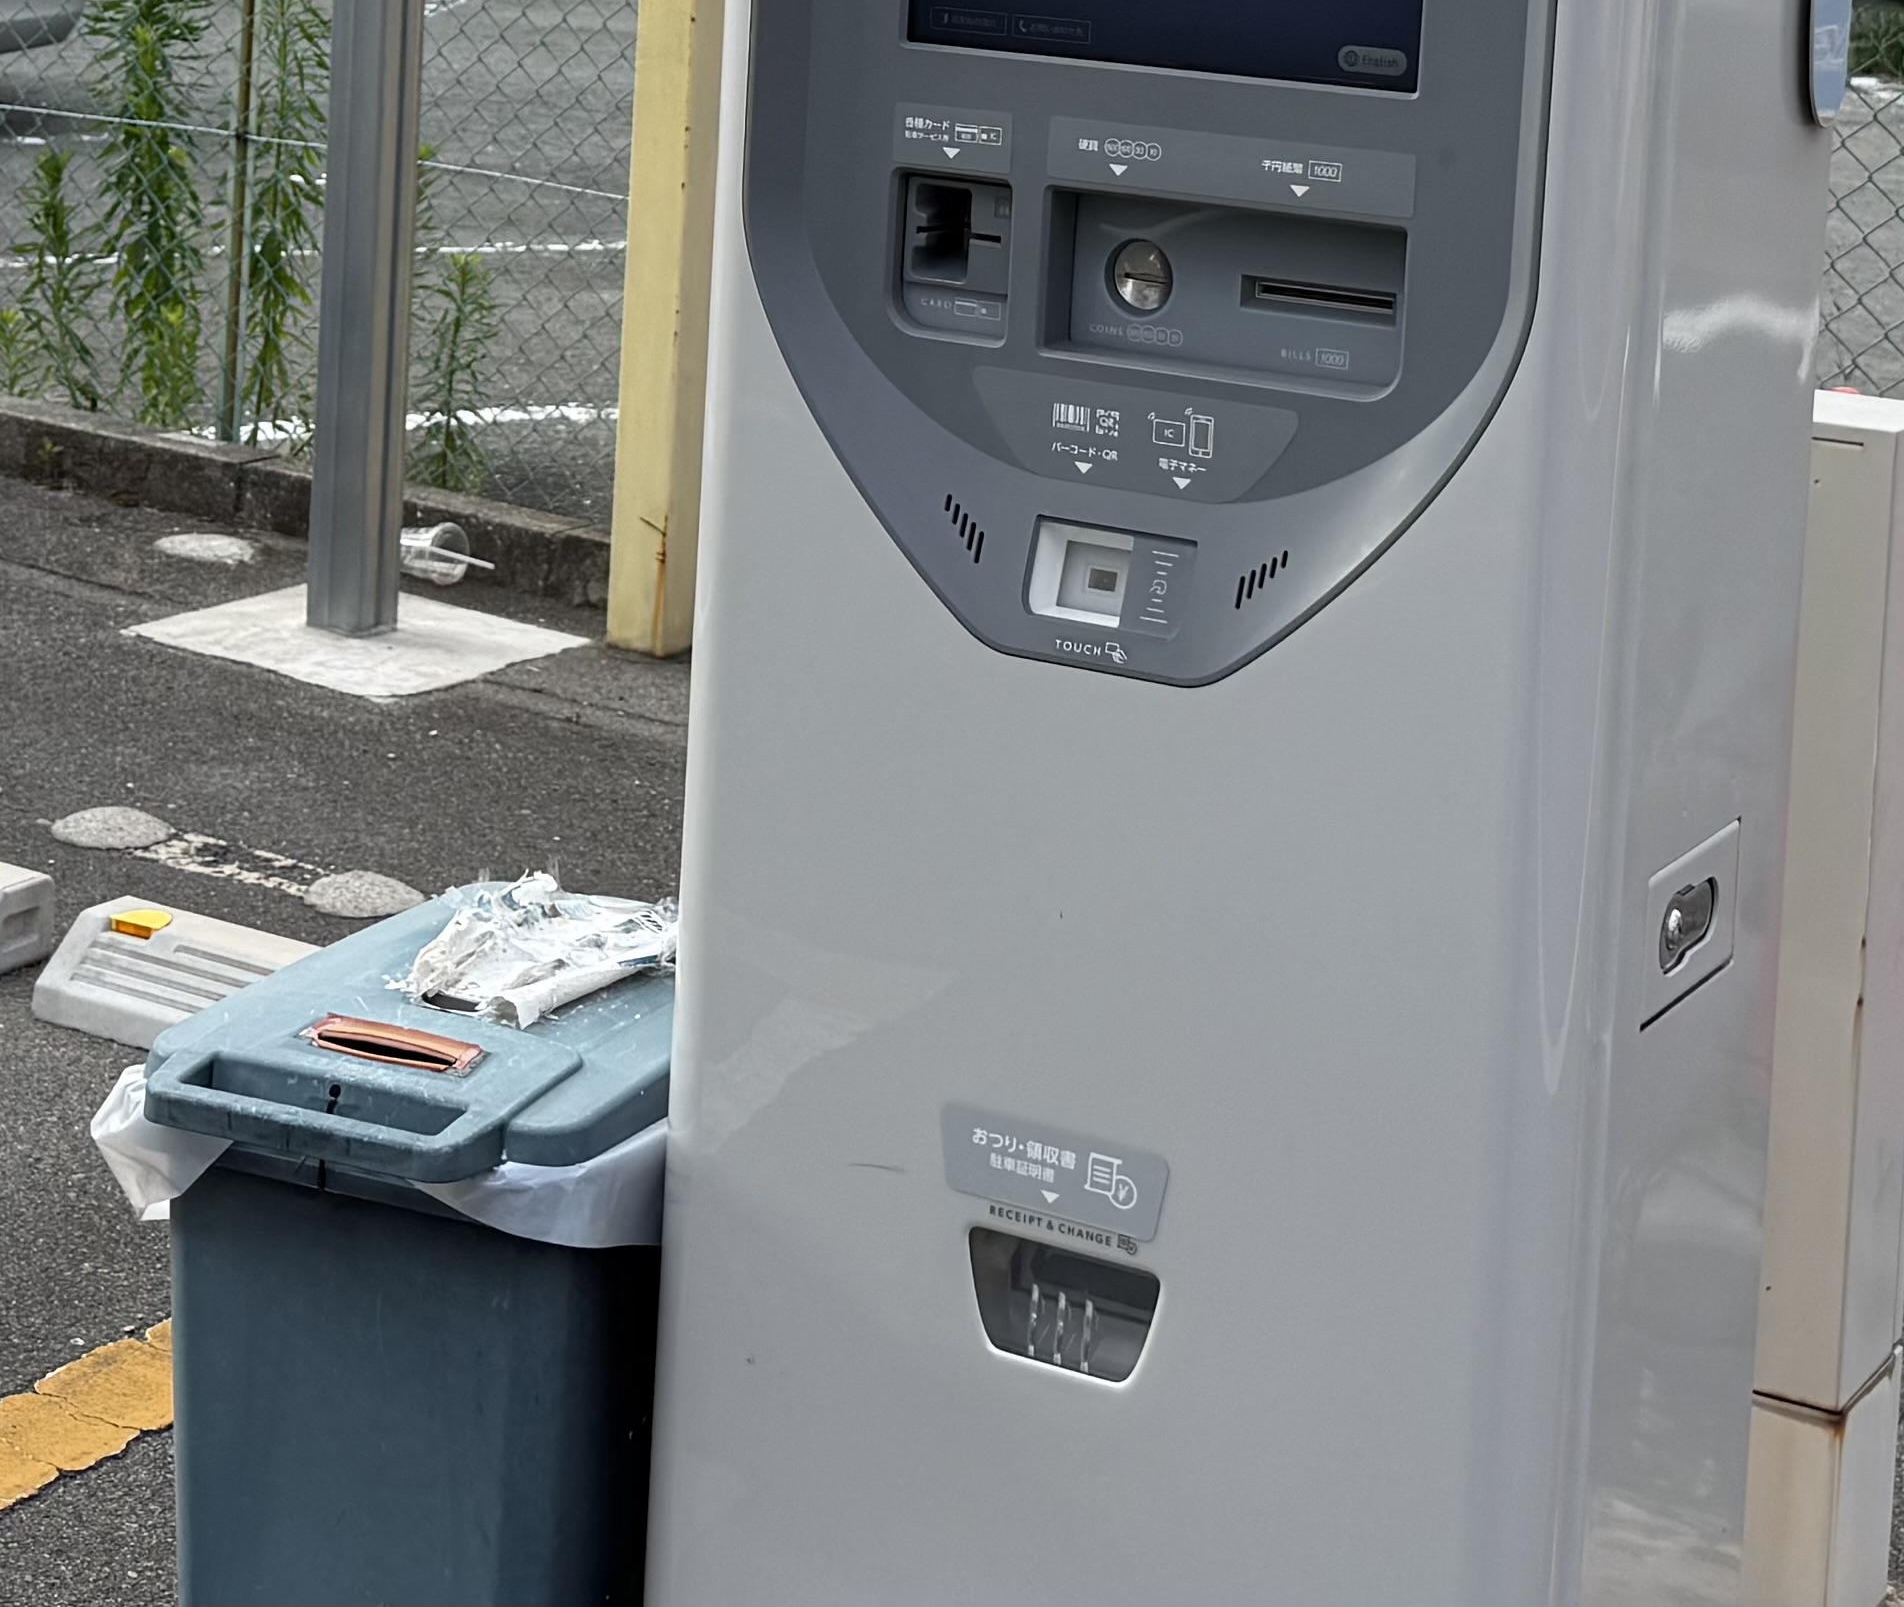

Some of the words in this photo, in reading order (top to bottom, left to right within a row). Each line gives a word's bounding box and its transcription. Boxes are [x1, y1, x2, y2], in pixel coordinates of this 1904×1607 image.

[1055, 638, 1102, 656] TOUCH
[972, 1127, 1077, 1170] おつり・領収書
[990, 1205, 1042, 1228] RECEIPT
[1046, 1219, 1054, 1232] &
[1058, 1223, 1113, 1247] CHANGE
